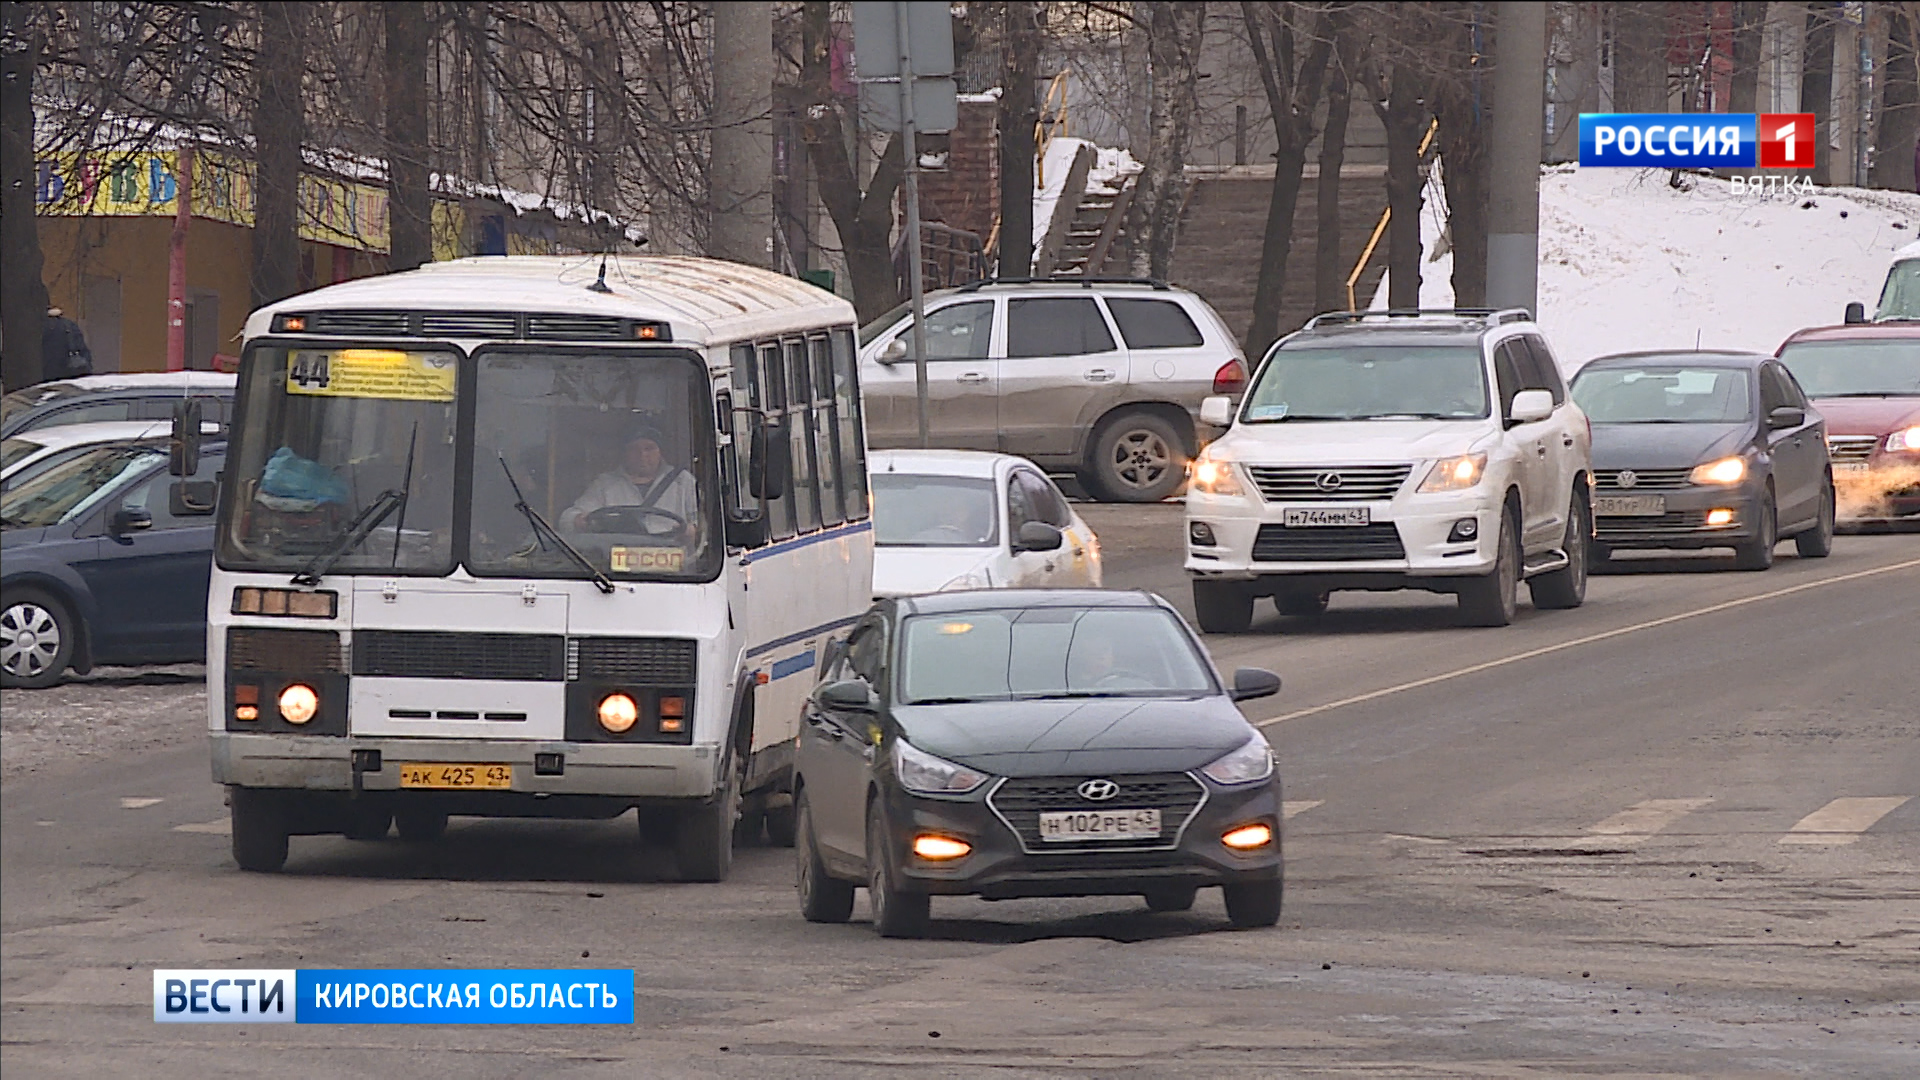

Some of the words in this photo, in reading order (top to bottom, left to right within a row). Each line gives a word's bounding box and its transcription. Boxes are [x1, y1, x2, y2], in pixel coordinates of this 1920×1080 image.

[36, 158, 177, 205] БУВЬ
[289, 353, 331, 388] 44
[410, 771, 433, 785] АК
[440, 767, 476, 786] 425
[486, 767, 505, 781] 43
